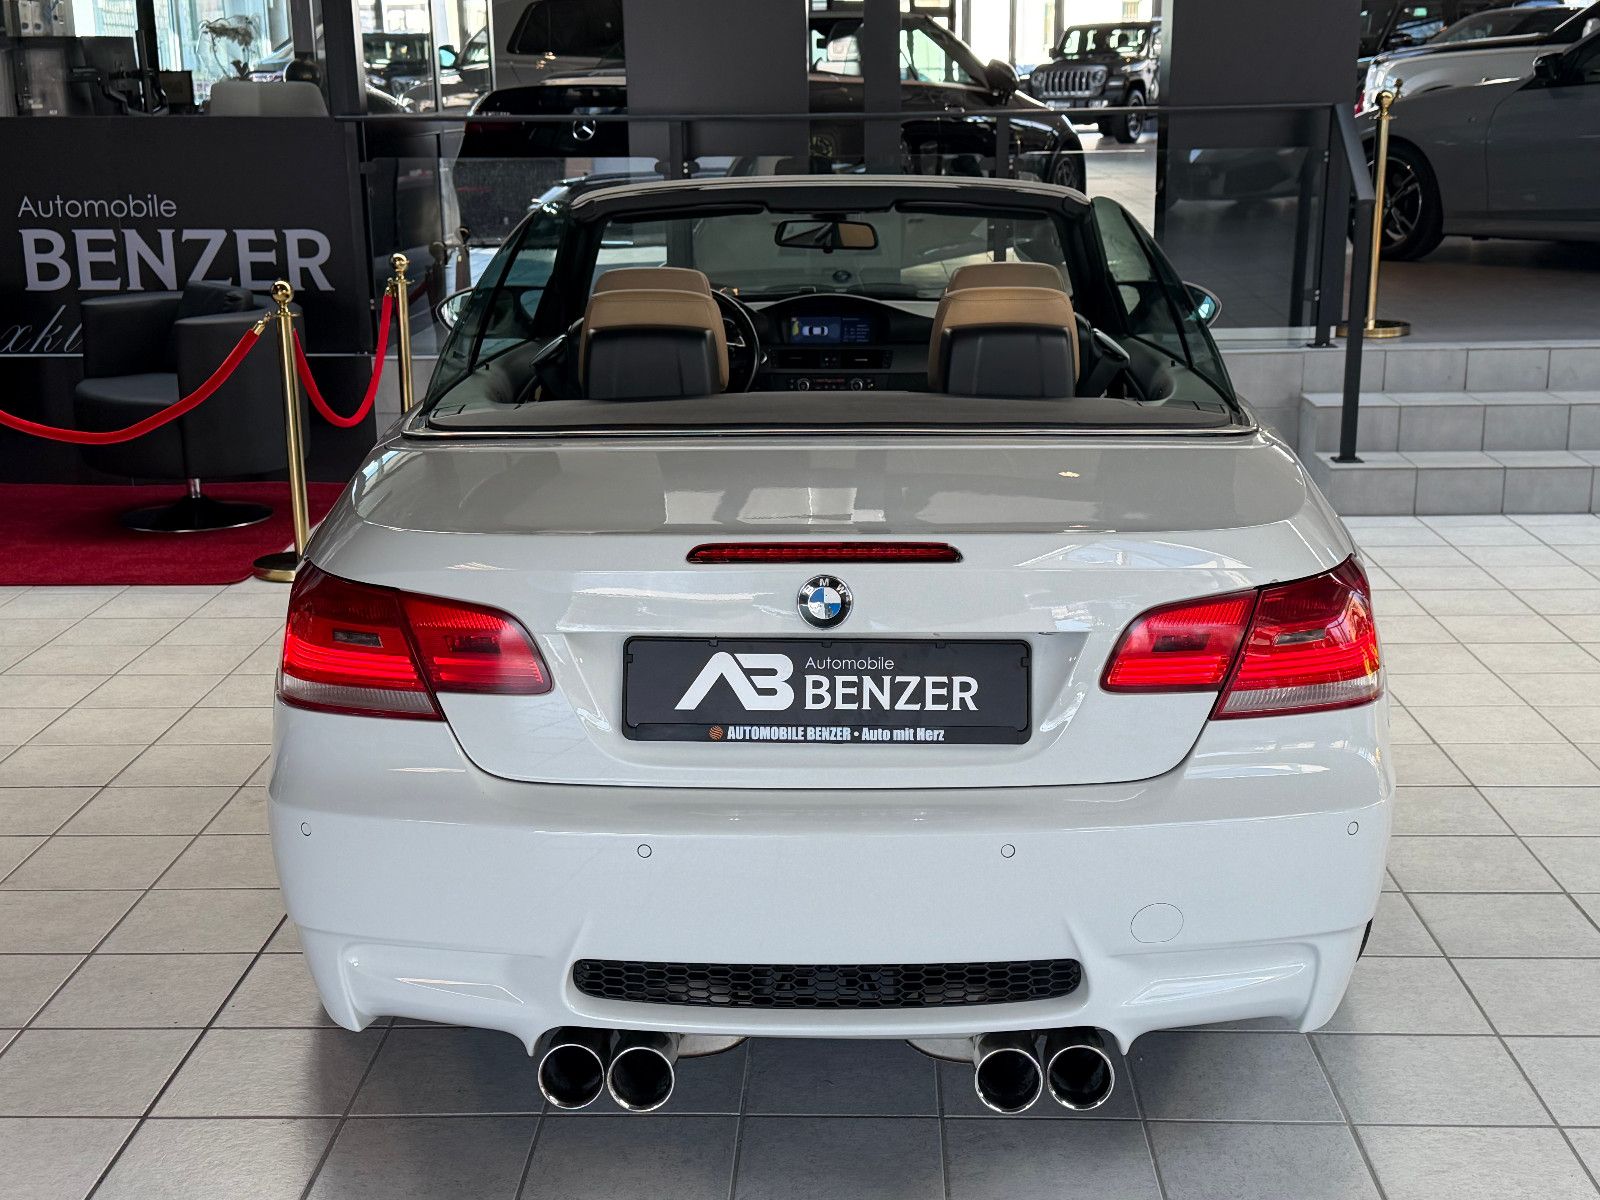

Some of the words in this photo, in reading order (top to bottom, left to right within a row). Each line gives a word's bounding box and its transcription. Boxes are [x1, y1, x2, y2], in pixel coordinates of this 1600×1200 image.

[18, 194, 177, 218] Automobile
[19, 229, 335, 291] BENZER
[802, 578, 847, 596] BMW
[805, 656, 895, 670] Automobile
[674, 651, 795, 711] AB
[804, 674, 979, 711] BENZER
[727, 726, 804, 740] AUTOMOBILE
[806, 726, 851, 741] BENZER
[861, 727, 890, 741] Auto
[892, 727, 915, 741] mit
[916, 727, 945, 741] Herz
